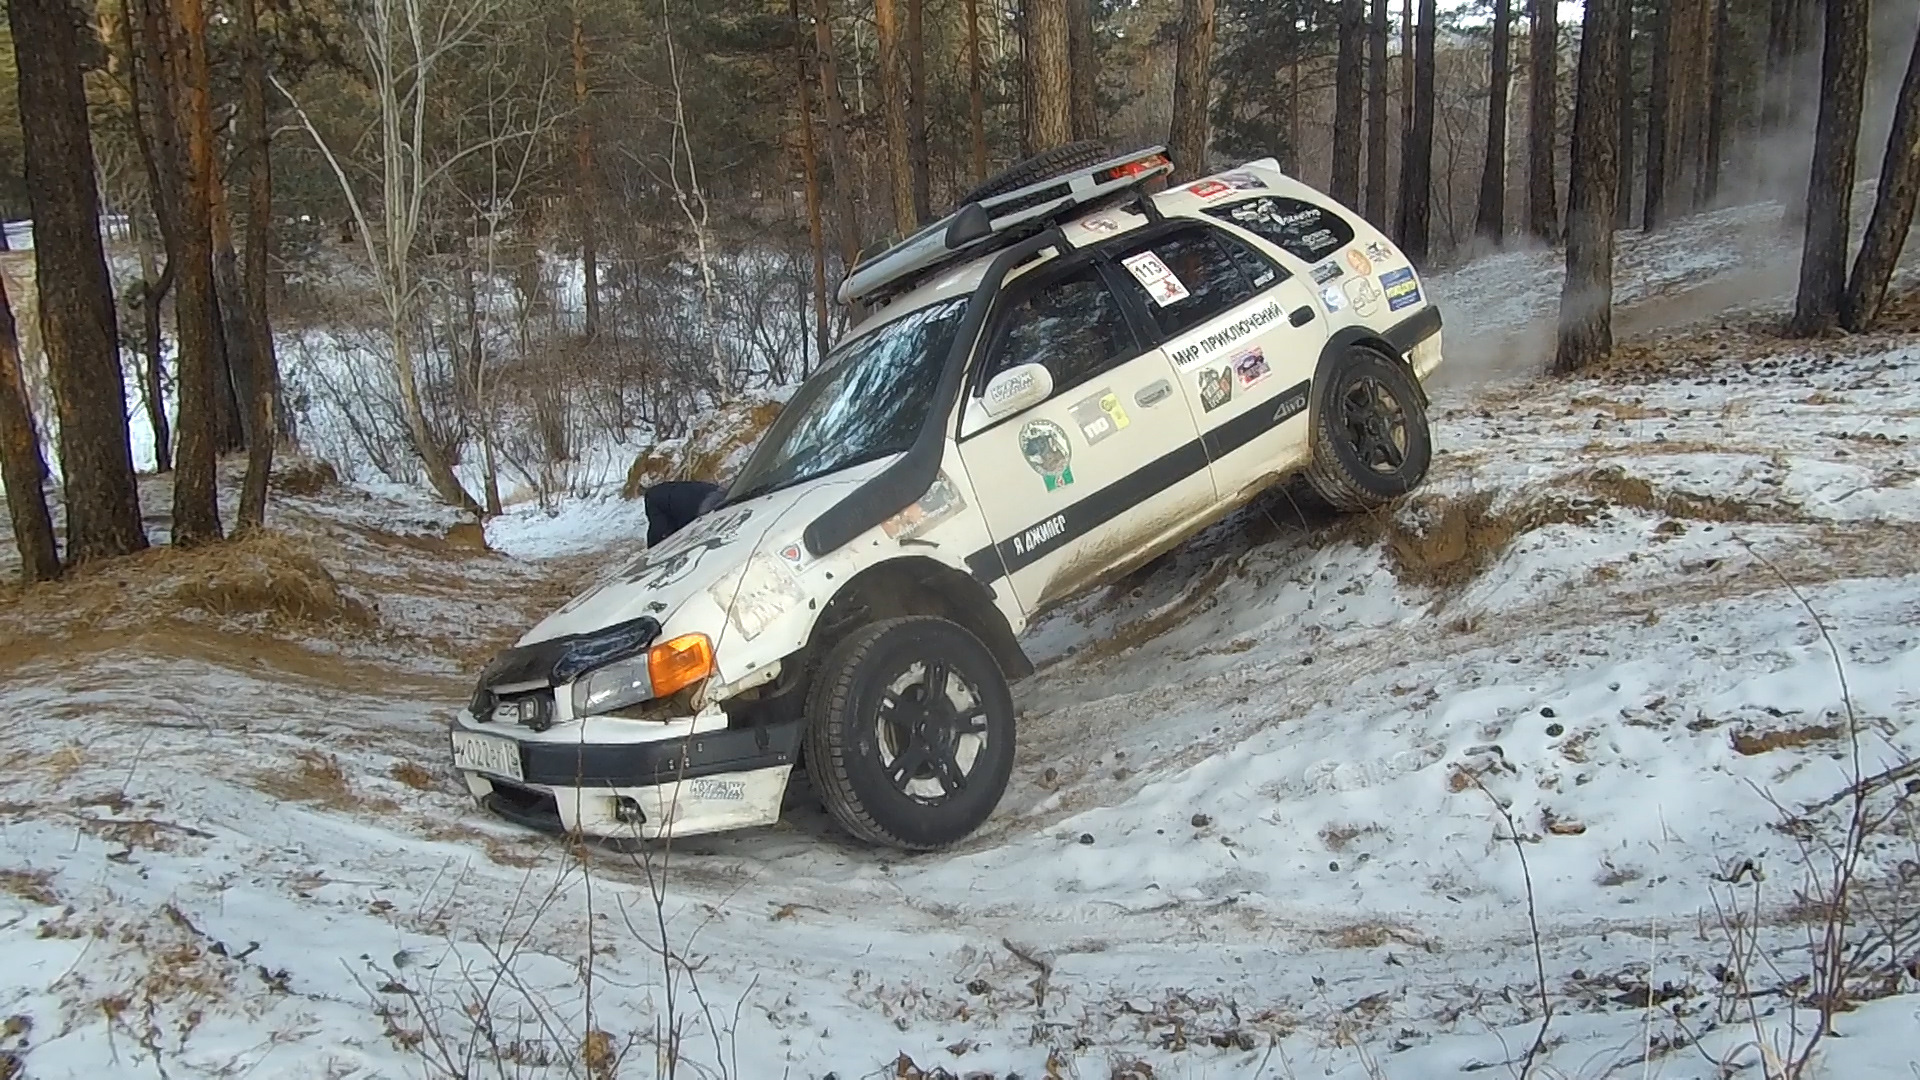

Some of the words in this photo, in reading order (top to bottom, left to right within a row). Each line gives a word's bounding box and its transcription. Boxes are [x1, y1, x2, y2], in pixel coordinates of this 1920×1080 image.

[1135, 261, 1162, 278] 113
[1172, 345, 1199, 366] МИР
[1200, 302, 1283, 354] ПРИКЛЮЧЕНИЙ
[1013, 537, 1025, 556] Я
[1025, 514, 1066, 552] ДЖИПЕР
